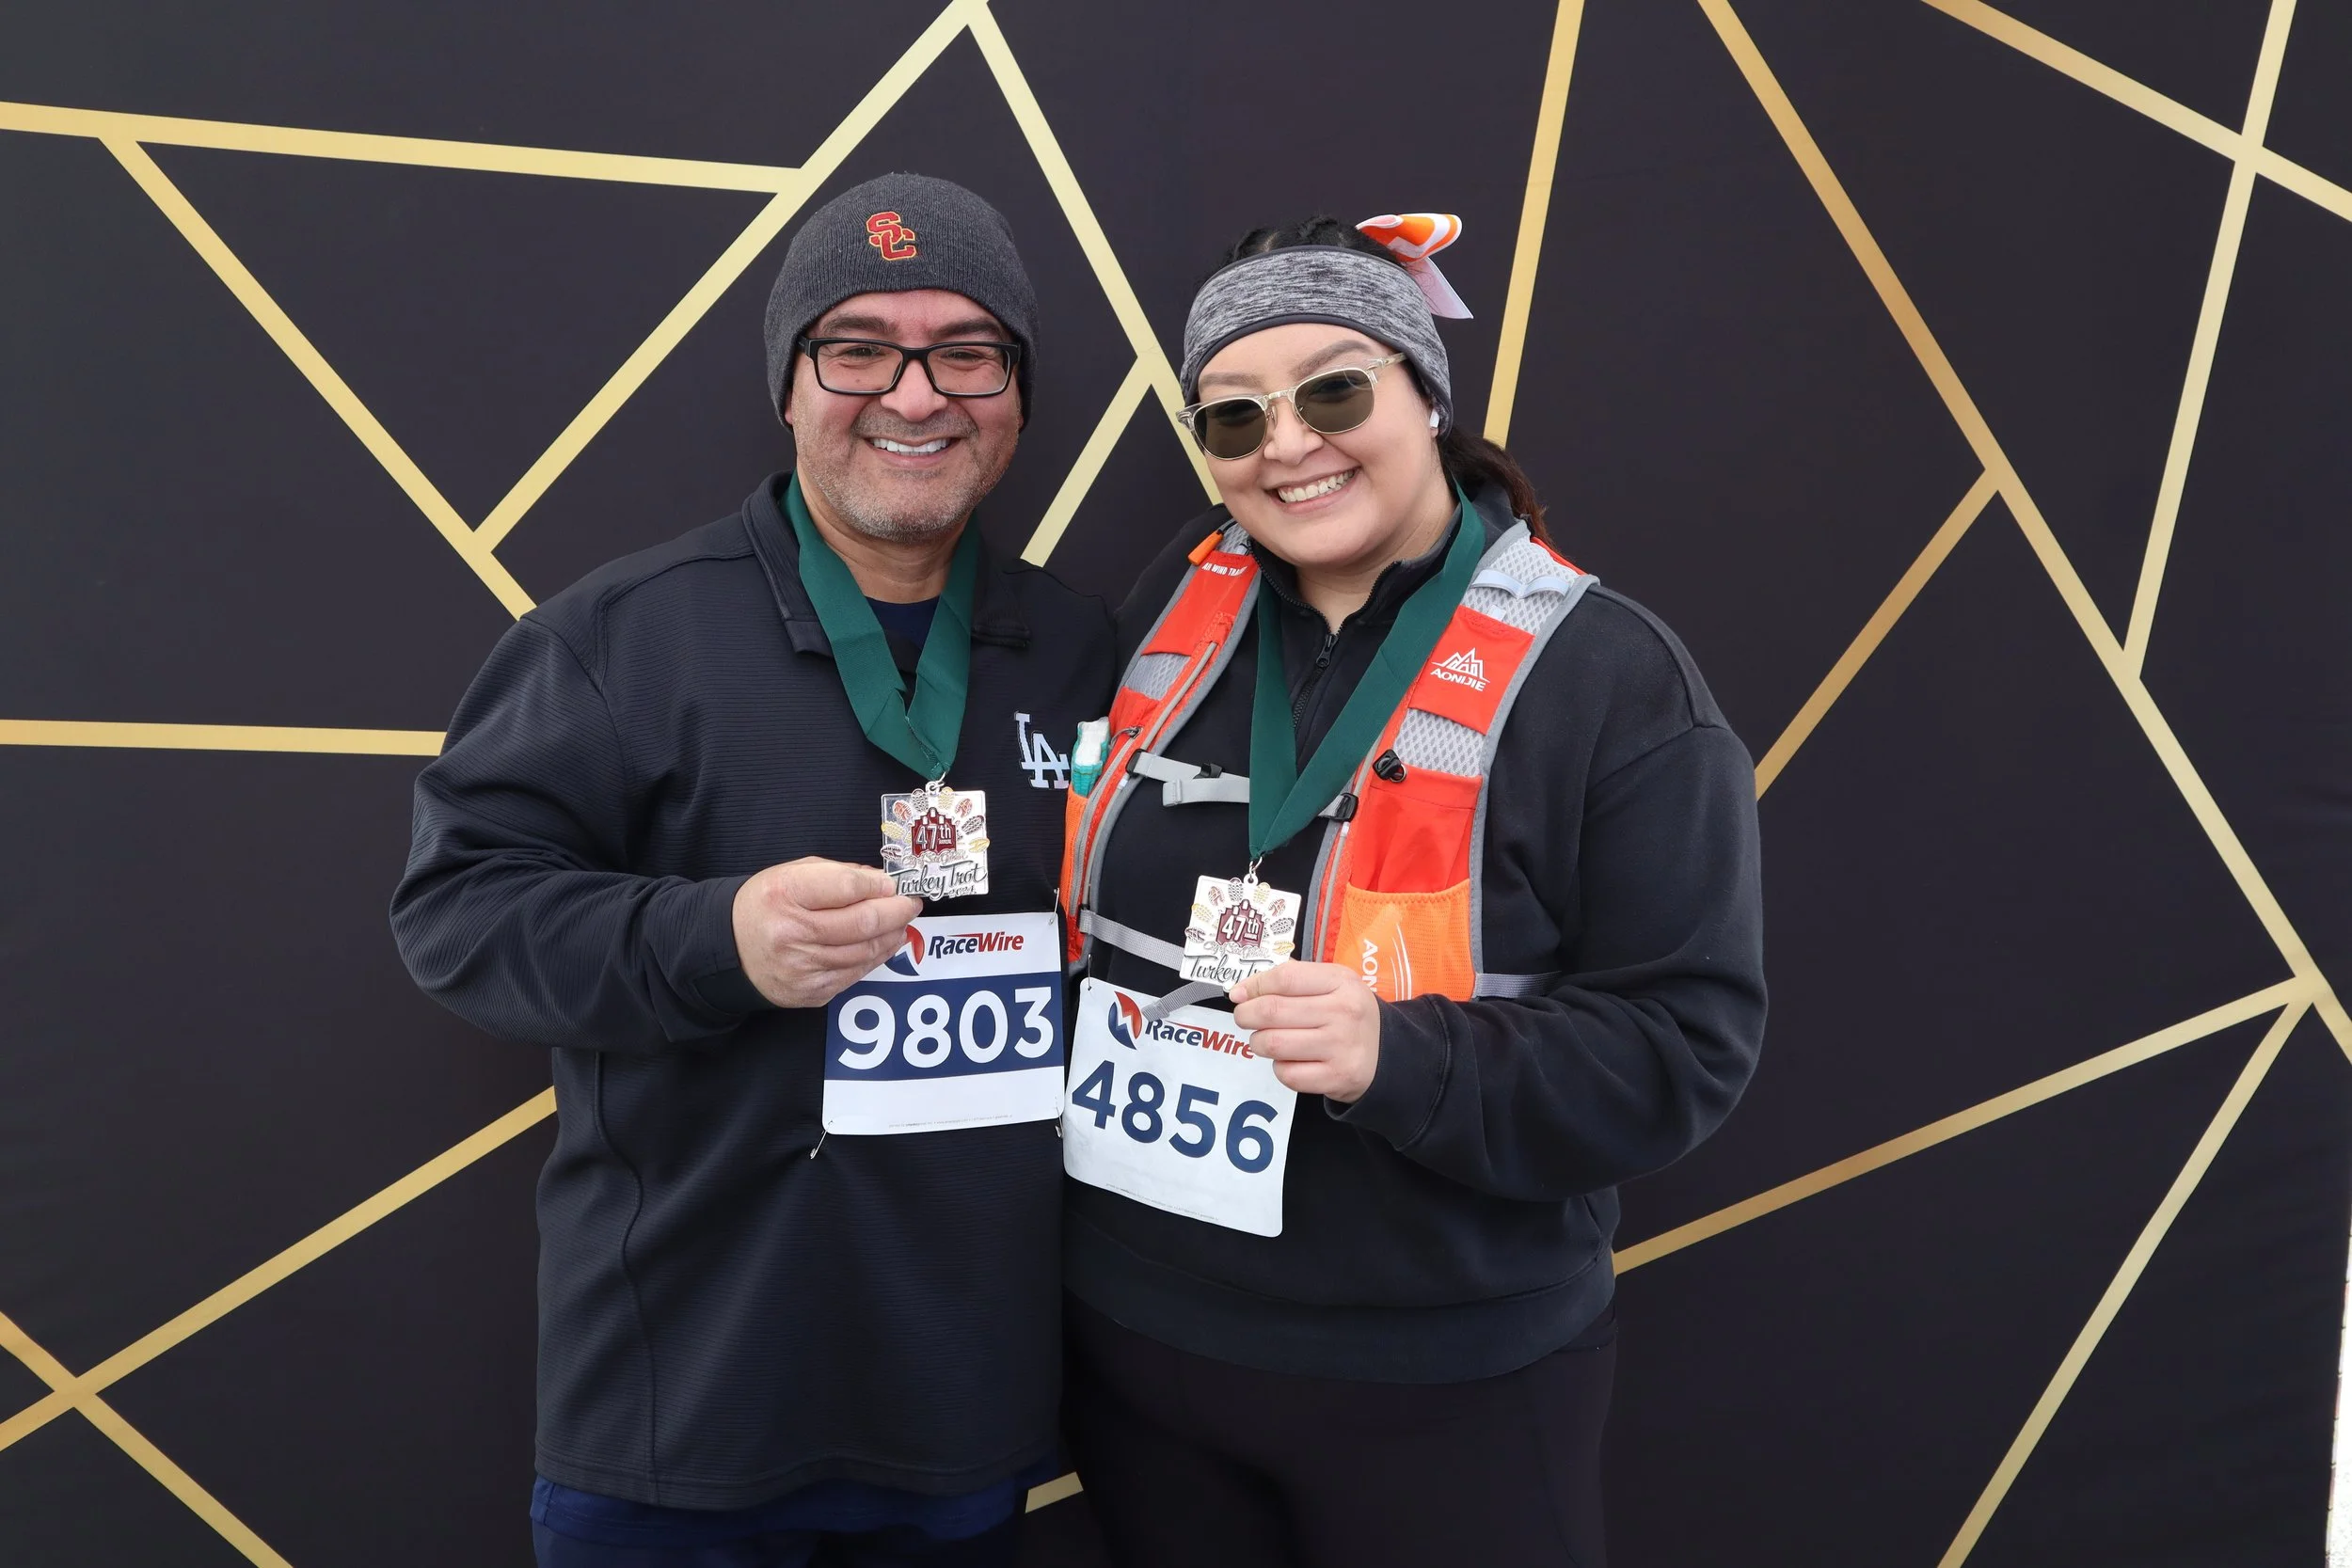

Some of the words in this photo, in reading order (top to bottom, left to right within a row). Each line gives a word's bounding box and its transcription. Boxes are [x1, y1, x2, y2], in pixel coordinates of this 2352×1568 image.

[866, 212, 916, 261] SC
[1430, 668, 1486, 691] AONIJIE
[1015, 712, 1071, 789] LA
[916, 823, 952, 850] 47th
[888, 863, 946, 900] Turkey
[939, 860, 988, 888] Trot
[928, 931, 1025, 958] RaceWire
[1221, 914, 1260, 942] 47th
[1184, 953, 1242, 984] Turkey
[837, 986, 1054, 1070] 9803
[1145, 1019, 1255, 1059] RaceWire
[1072, 1059, 1279, 1174] 4856
